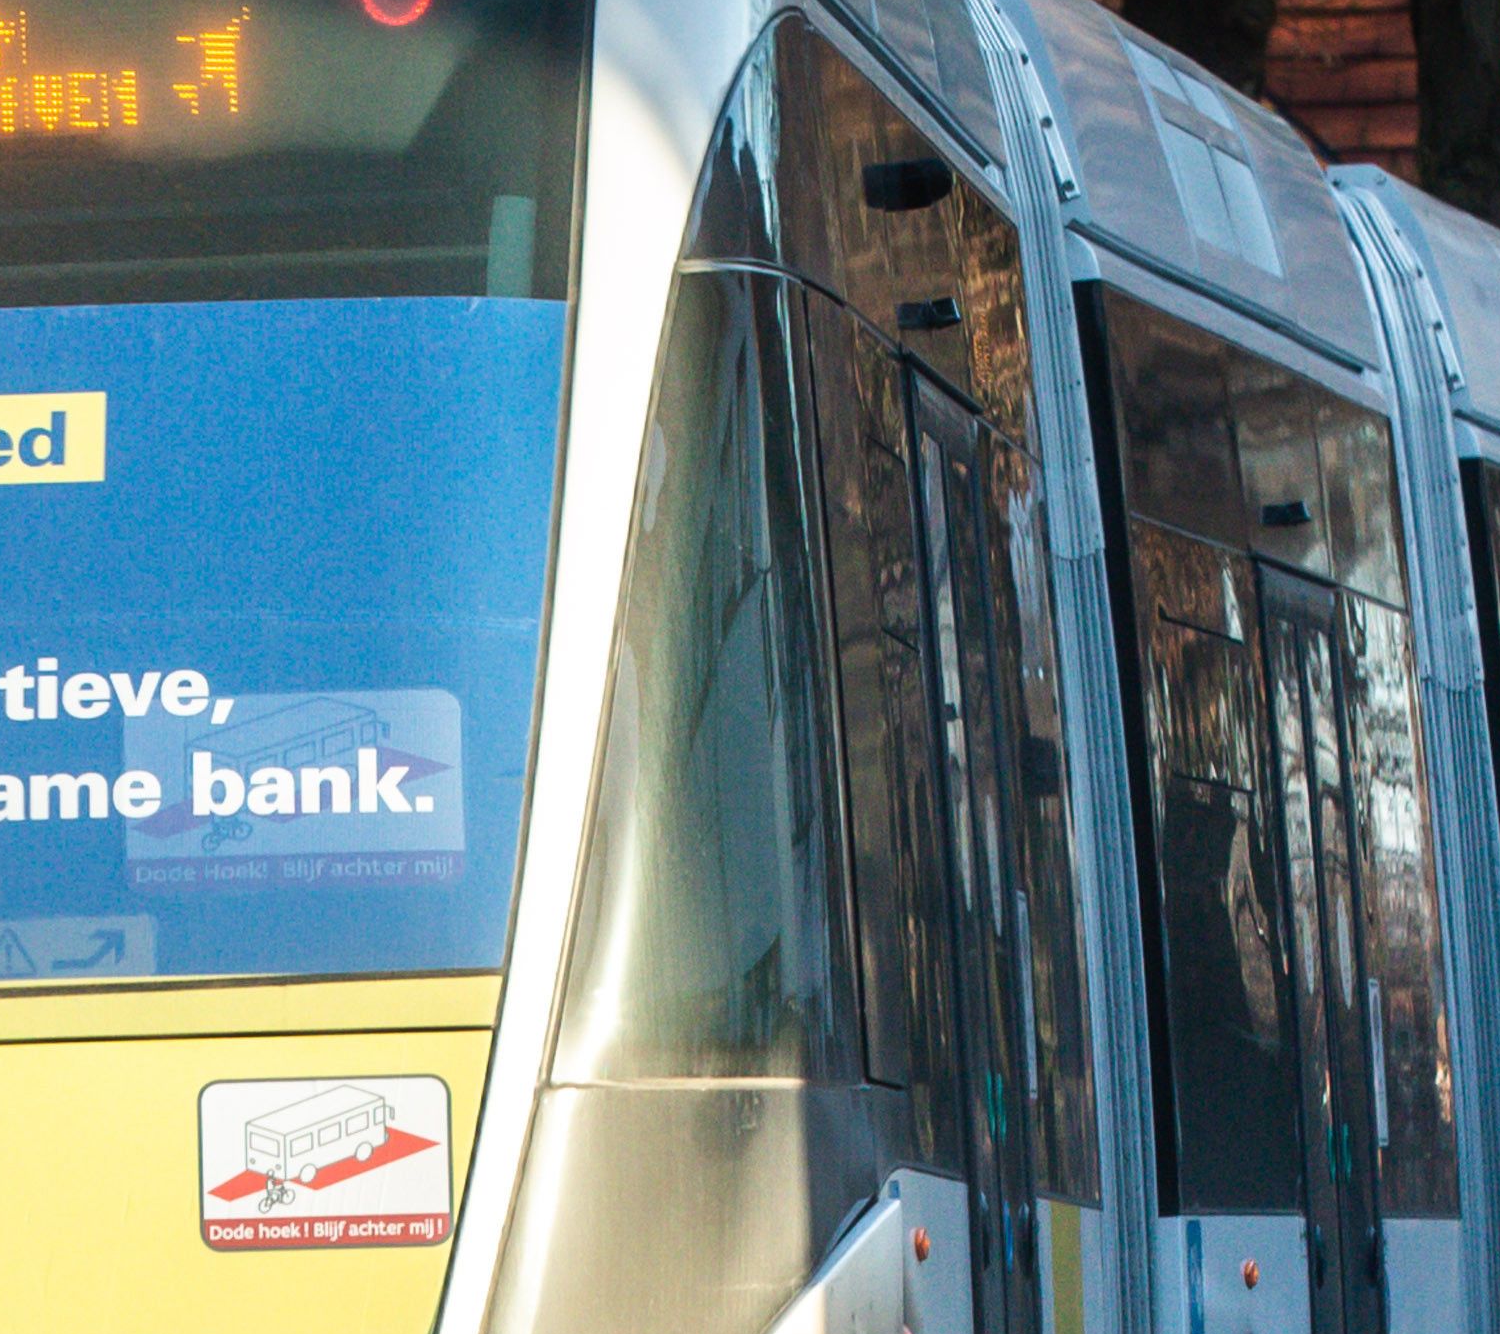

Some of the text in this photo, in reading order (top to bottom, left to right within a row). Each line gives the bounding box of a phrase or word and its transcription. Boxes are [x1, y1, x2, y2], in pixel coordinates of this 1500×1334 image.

[192, 748, 434, 817] bank.
[210, 1225, 253, 1240] Dode
[314, 1220, 346, 1241] Blijf
[348, 1221, 404, 1237] achter
